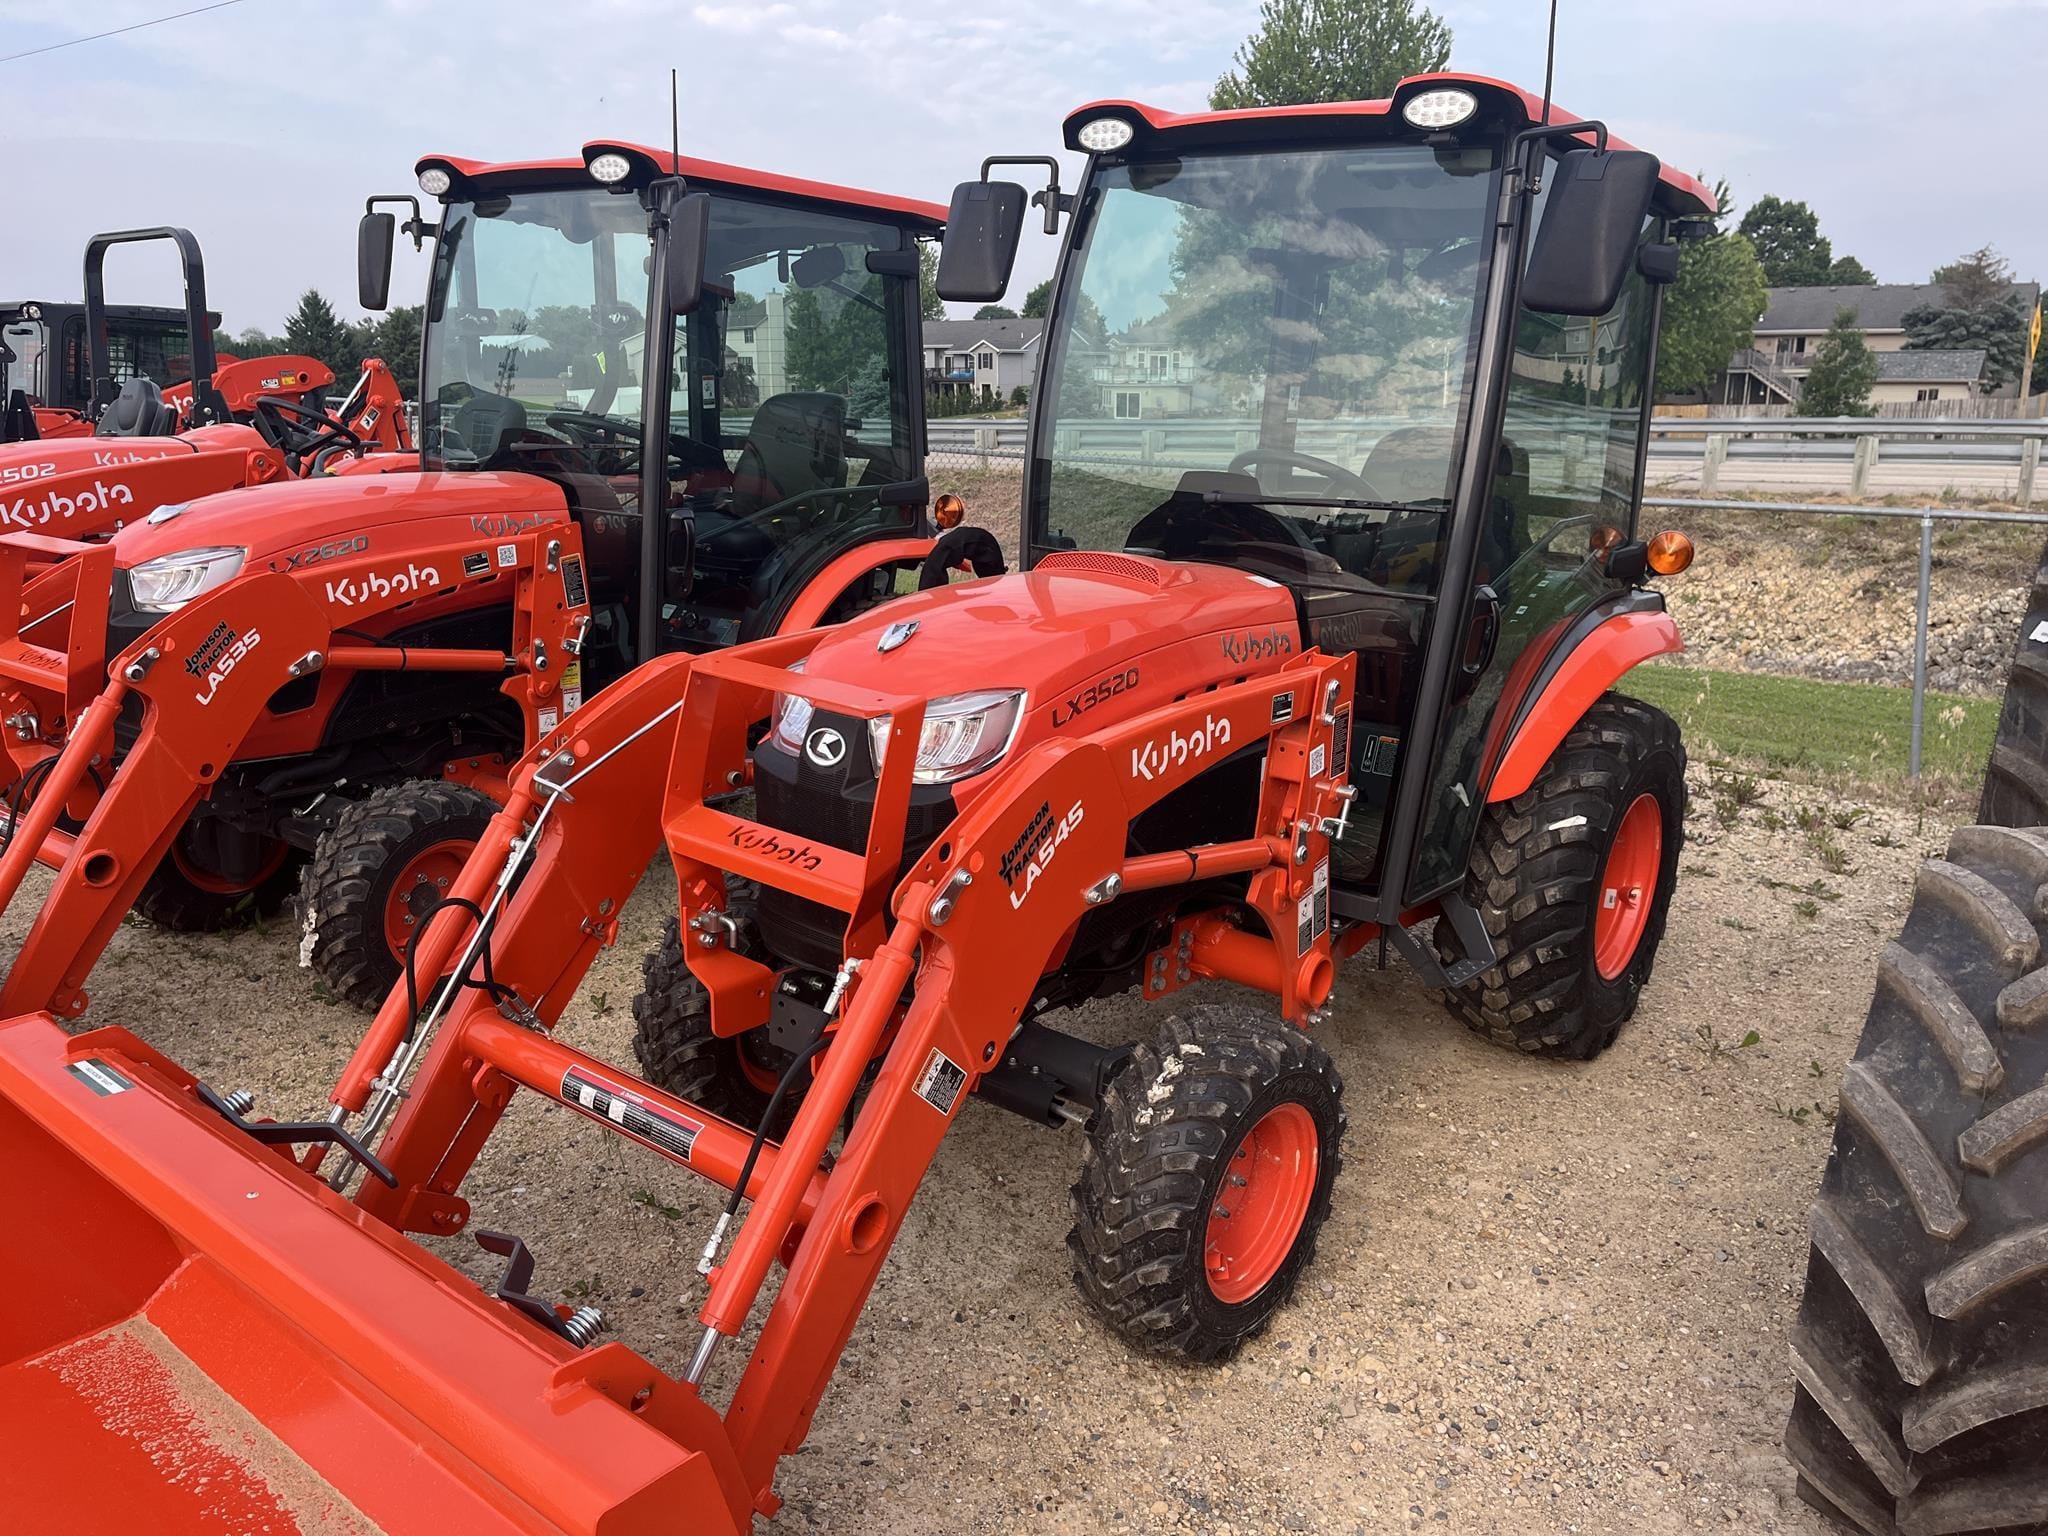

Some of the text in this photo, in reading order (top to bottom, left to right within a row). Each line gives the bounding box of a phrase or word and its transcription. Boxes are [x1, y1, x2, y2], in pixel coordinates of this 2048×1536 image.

[0, 463, 56, 484] 502
[0, 481, 134, 528] Kubota
[325, 563, 440, 606] Kubota
[185, 621, 227, 673] JOHNSON
[191, 630, 237, 678] TRACTOR
[195, 628, 261, 706] LA535
[1221, 627, 1292, 664] Kubota
[1052, 667, 1140, 729] LX3520
[1132, 714, 1231, 780] Kubota
[728, 825, 822, 871] Kubota
[999, 800, 1050, 877] JOHNSON
[1003, 815, 1056, 888] TRACTOR
[1010, 800, 1084, 910] LA545
